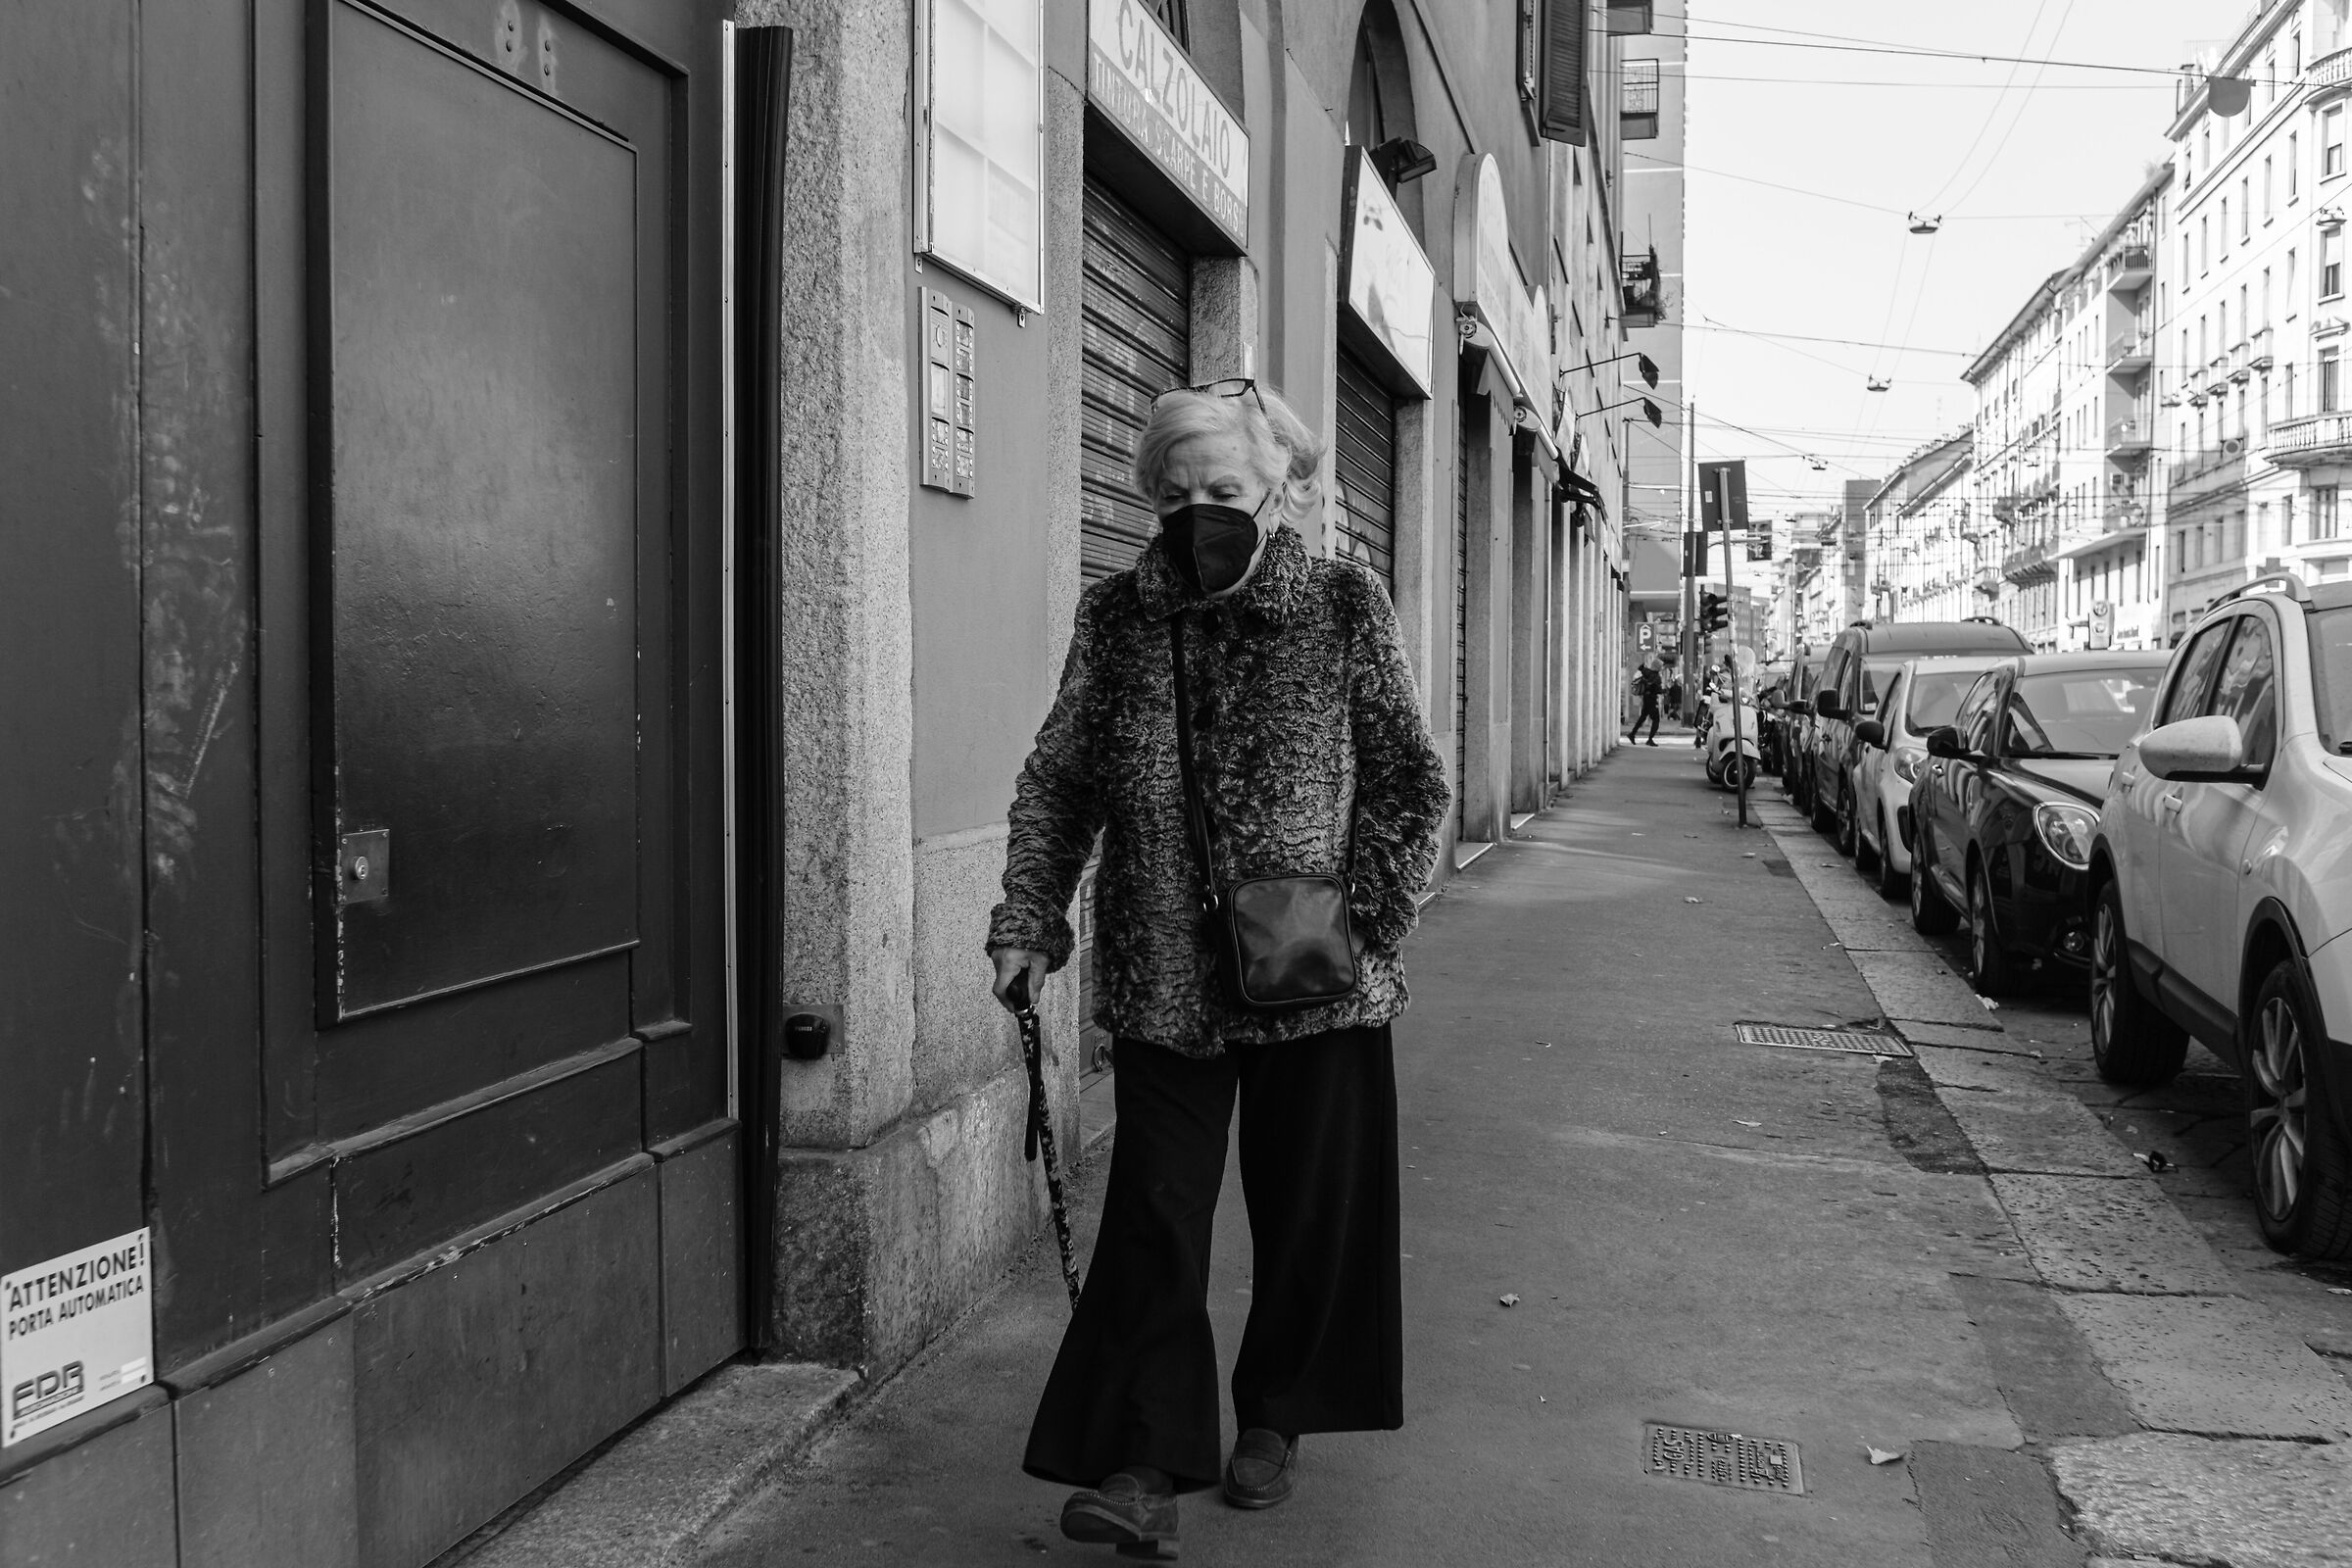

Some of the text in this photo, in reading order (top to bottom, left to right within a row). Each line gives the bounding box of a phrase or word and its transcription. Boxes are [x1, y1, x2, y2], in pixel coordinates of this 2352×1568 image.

[1119, 0, 1230, 178] CALZOLAIO
[1094, 53, 1150, 144] TINTURA
[1155, 122, 1197, 191] SCARPE
[1201, 172, 1208, 200] E
[1639, 628, 1652, 644] P
[9, 1243, 144, 1312] ATTENZIONE!
[9, 1276, 144, 1341] PORTA AUTOMATICA
[14, 1360, 84, 1420] FDR
[1662, 1438, 1685, 1461] GAS
